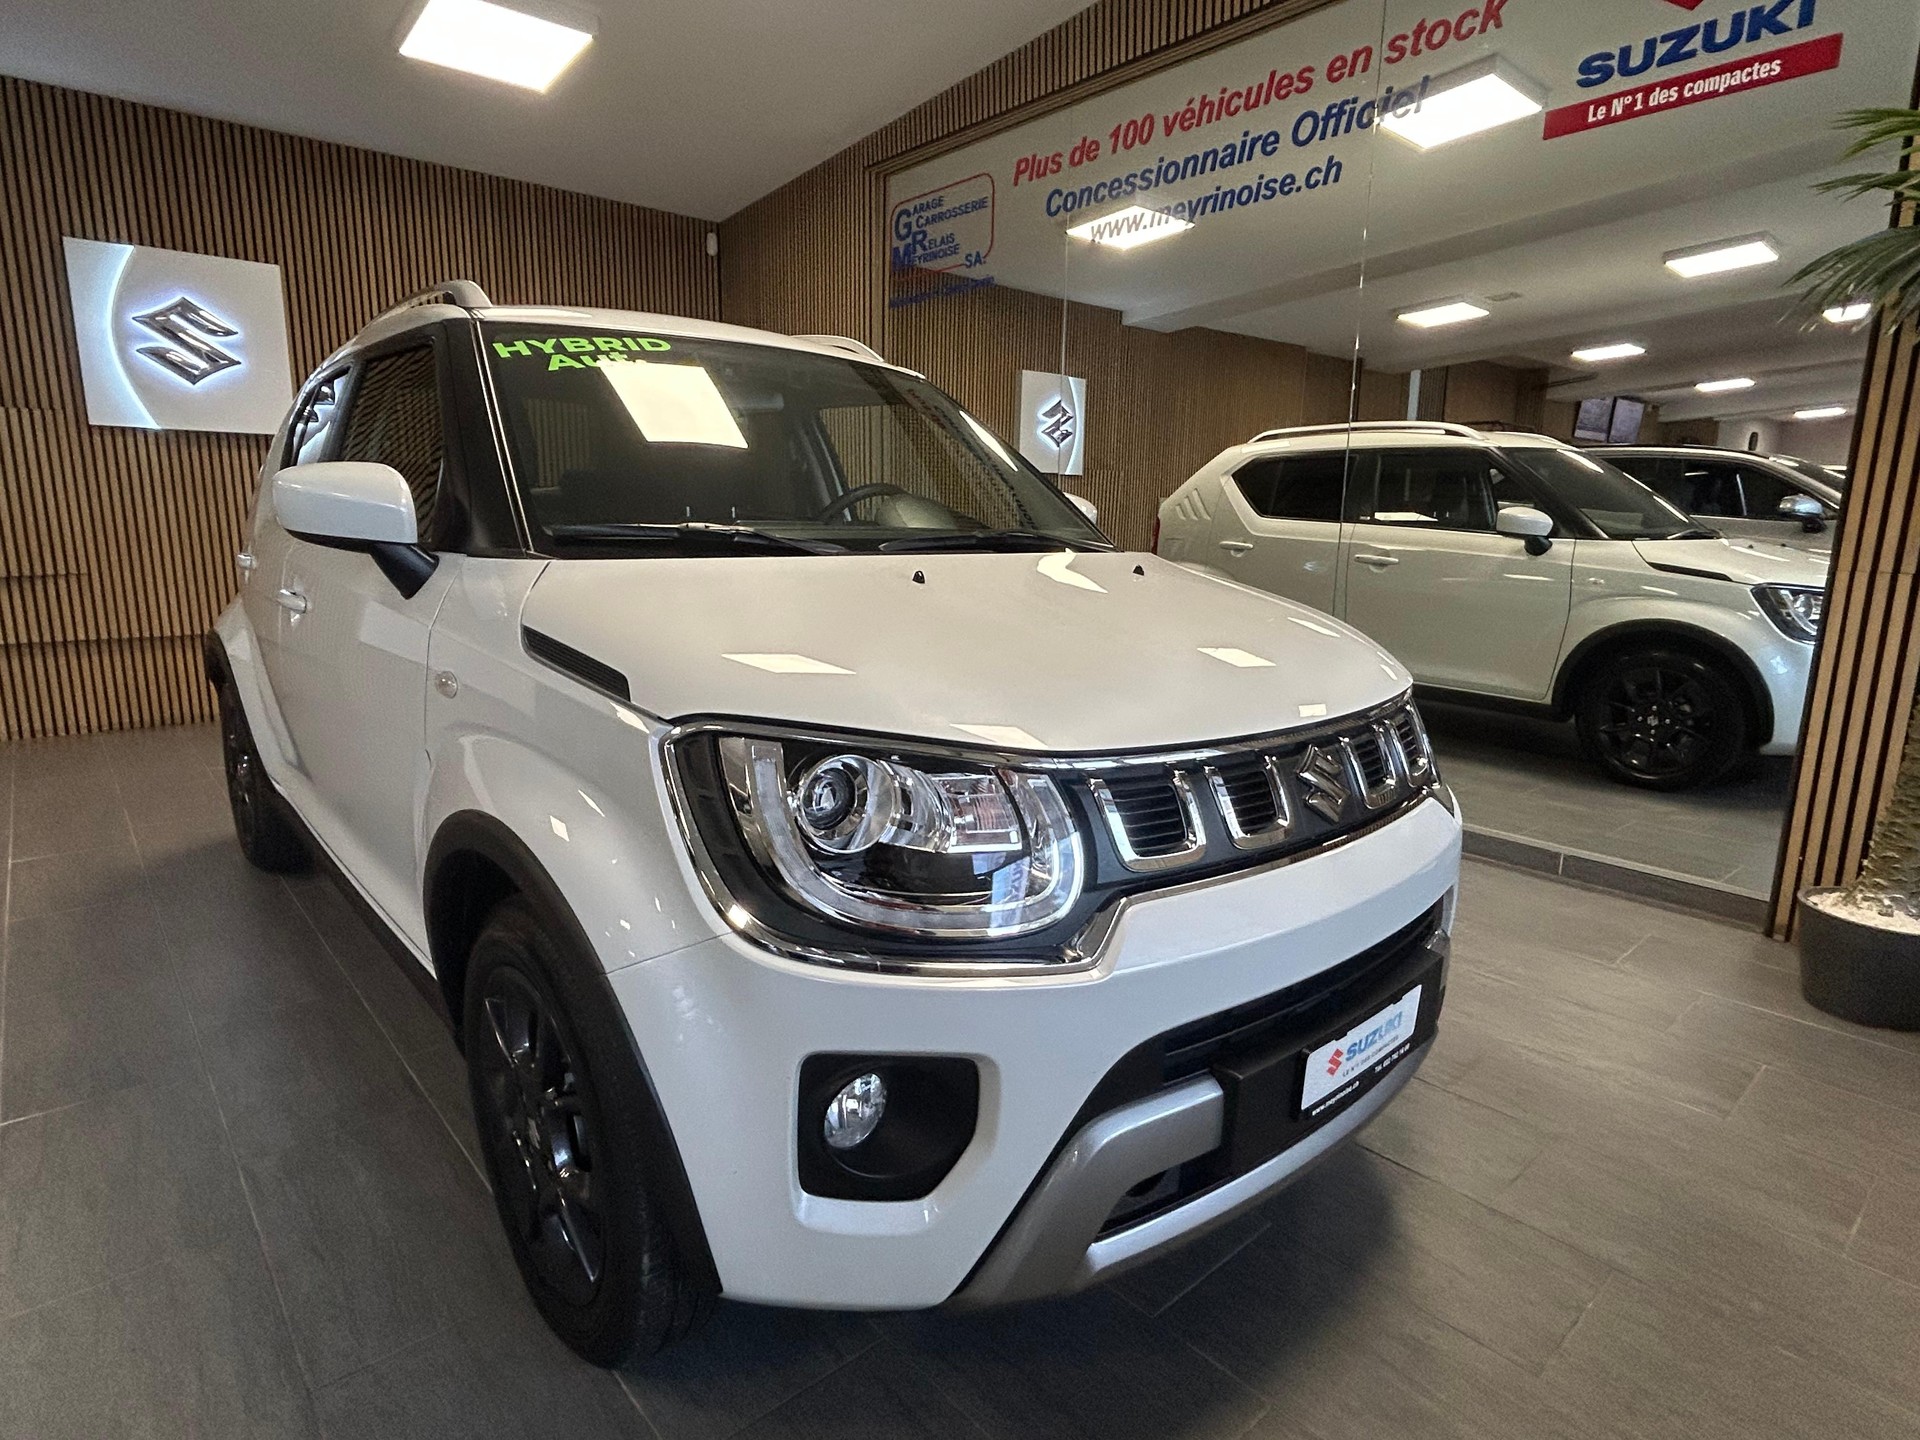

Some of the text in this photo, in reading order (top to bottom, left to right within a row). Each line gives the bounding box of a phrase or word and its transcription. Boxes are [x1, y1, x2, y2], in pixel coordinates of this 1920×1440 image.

[1577, 0, 1817, 88] SUZUKI
[1013, 0, 1507, 187] Plus de 100 véhicules en stock
[1587, 103, 1606, 123] Le
[1648, 86, 1679, 107] des
[1683, 59, 1782, 97] compactes
[1045, 74, 1430, 217] Concessionnaire Officiel
[894, 195, 944, 241] GARAGE
[915, 196, 989, 229] CARROSSERIE
[1090, 154, 1343, 242] www.meyrinoise.ch
[911, 229, 955, 254] RELAIS
[493, 336, 672, 358] HYBRID
